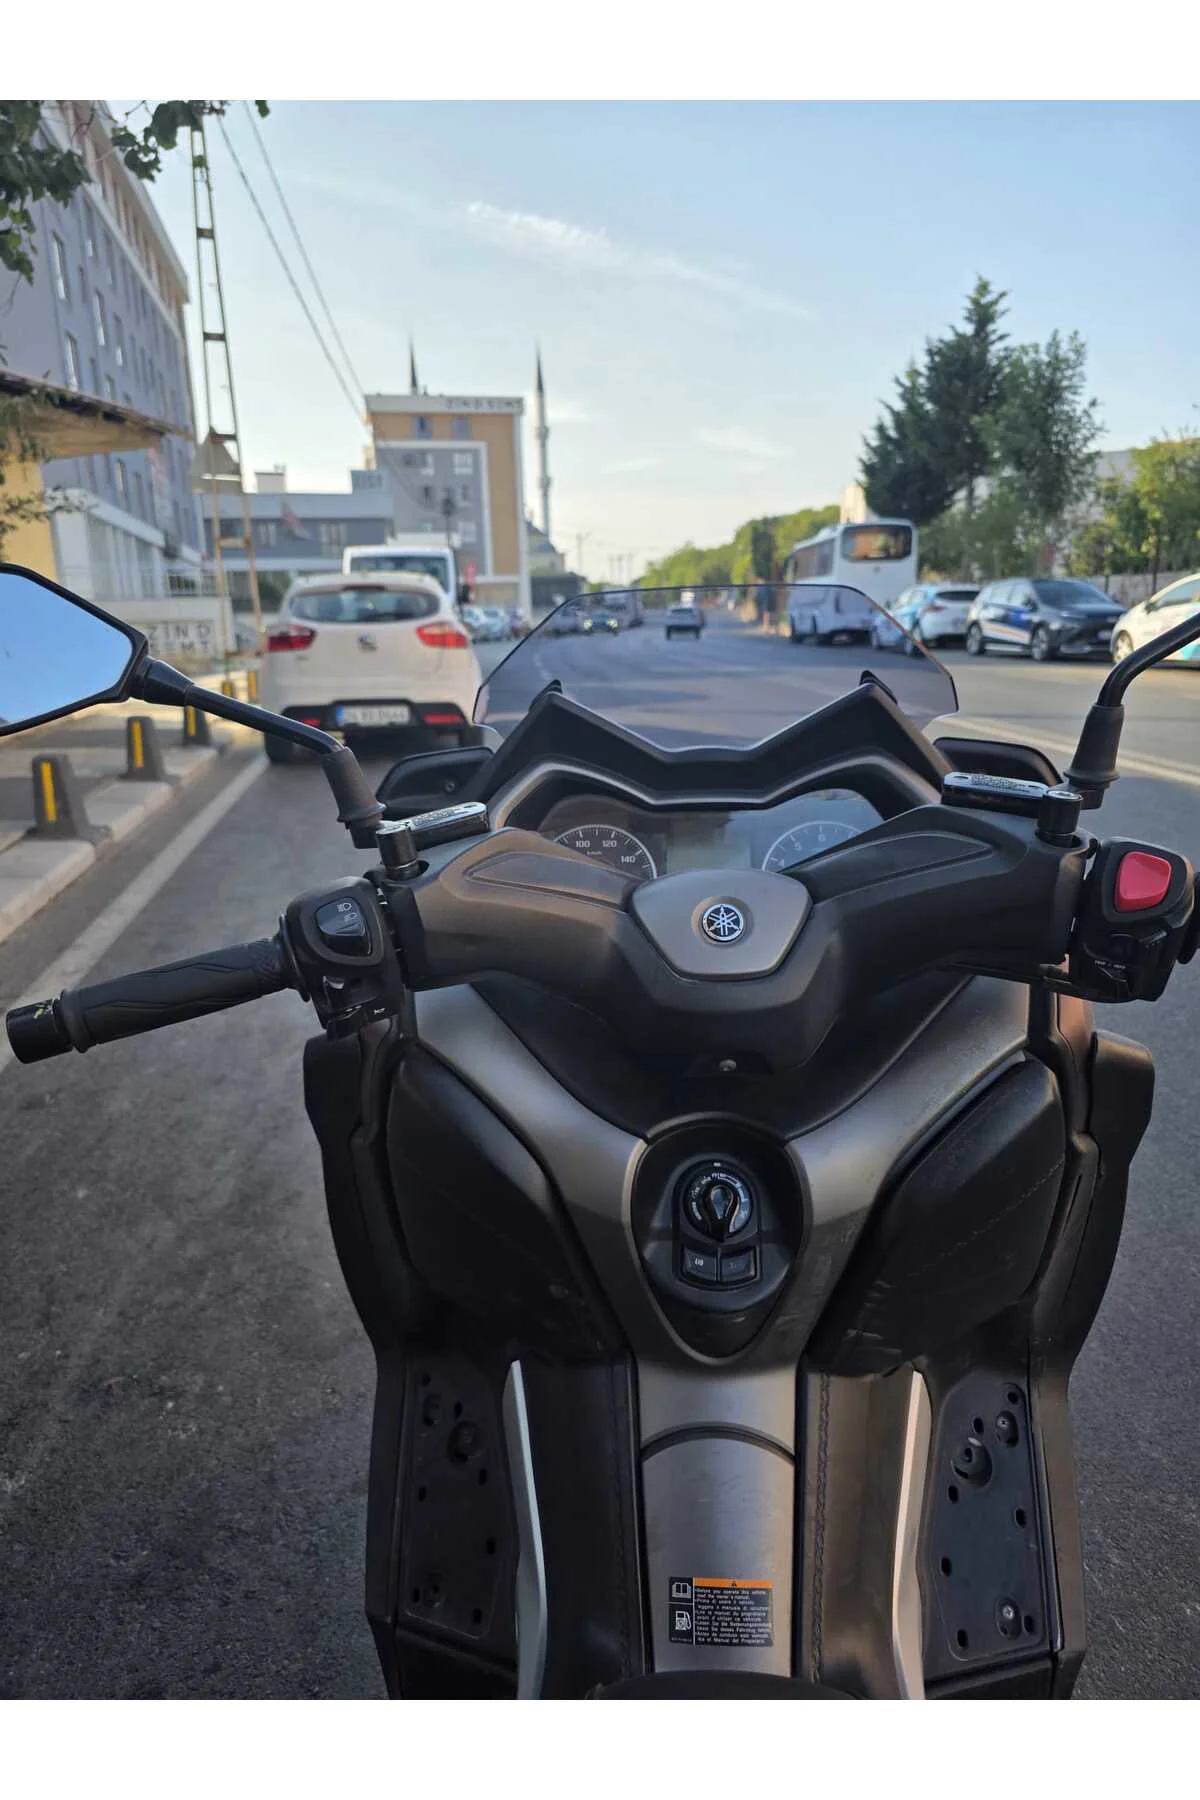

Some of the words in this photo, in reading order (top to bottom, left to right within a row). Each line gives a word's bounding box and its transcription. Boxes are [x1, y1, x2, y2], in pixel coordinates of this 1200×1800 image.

[575, 840, 591, 848] 100
[602, 840, 618, 848] 120
[621, 855, 636, 863] 140
